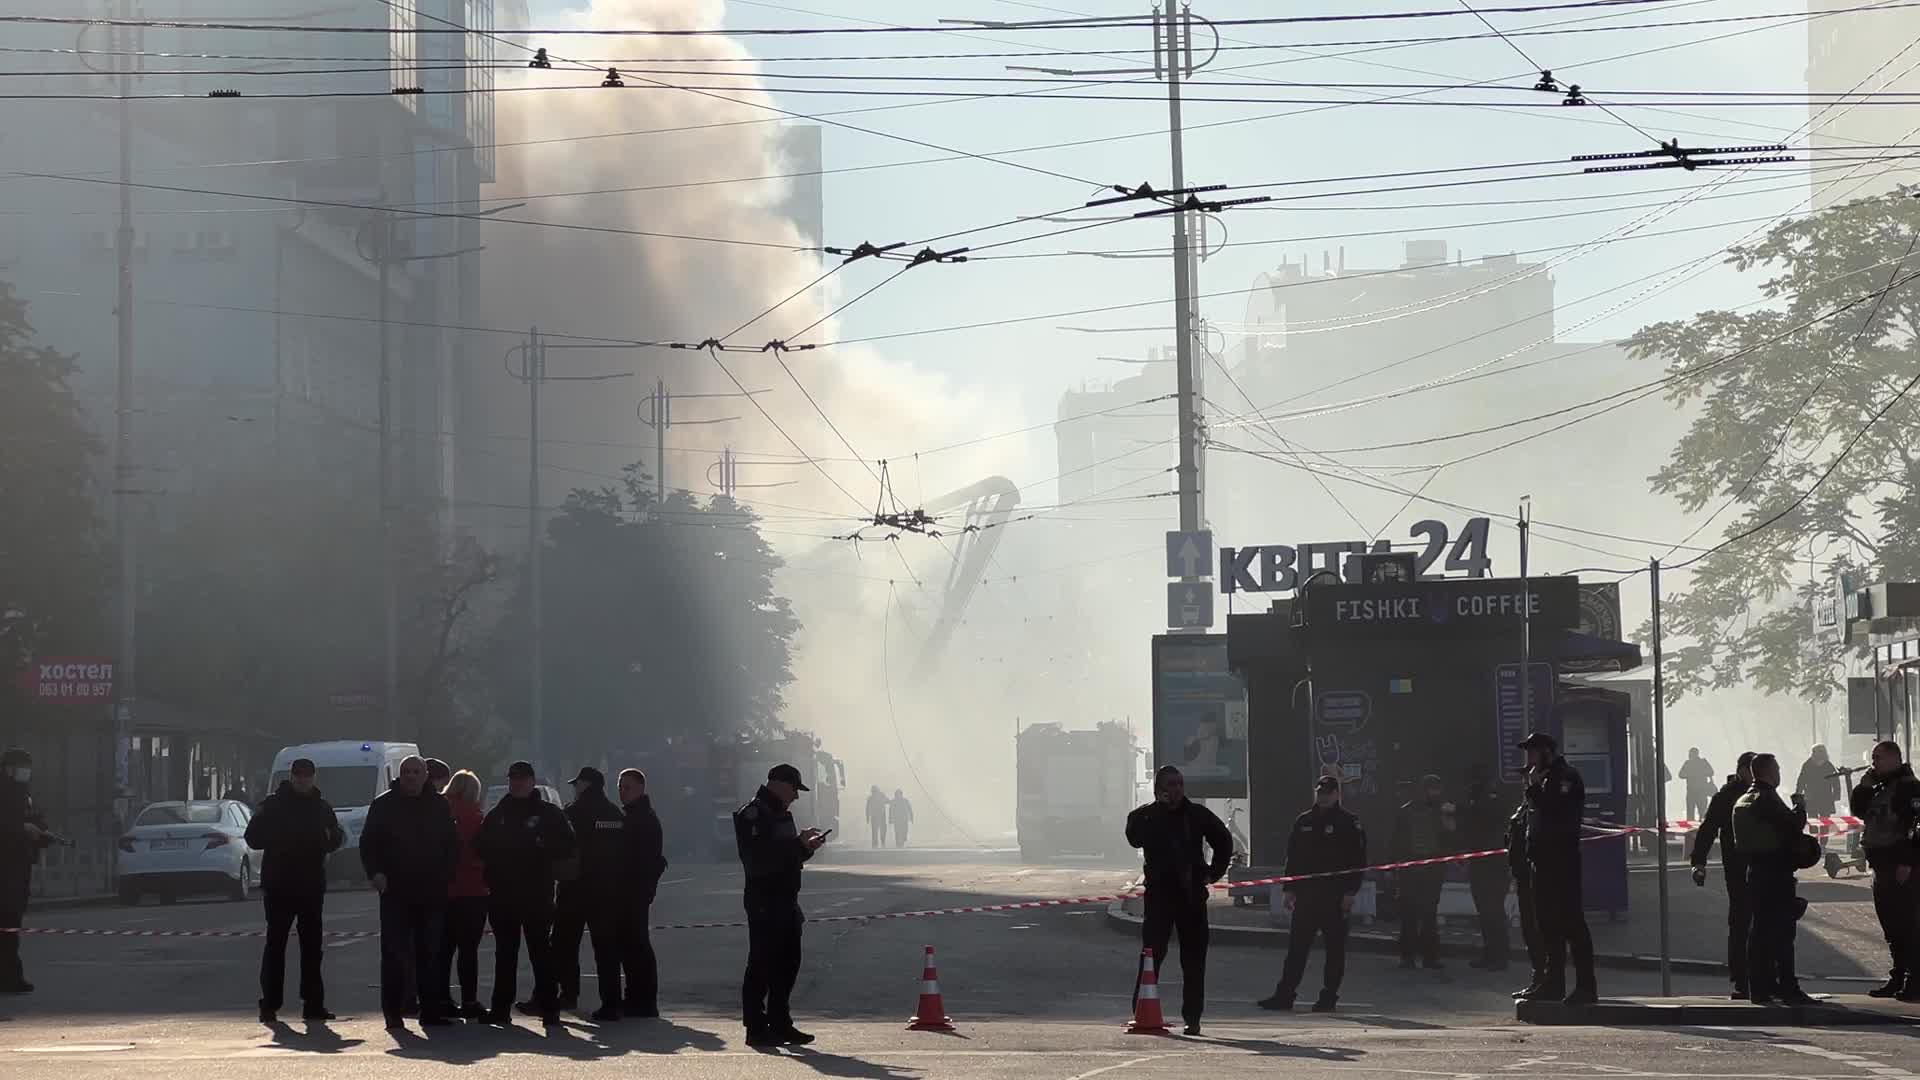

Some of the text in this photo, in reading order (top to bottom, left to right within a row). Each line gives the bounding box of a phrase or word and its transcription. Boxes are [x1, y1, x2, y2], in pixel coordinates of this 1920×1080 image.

[1410, 517, 1491, 579] 24
[1336, 593, 1541, 621] FISHKI COFFEE
